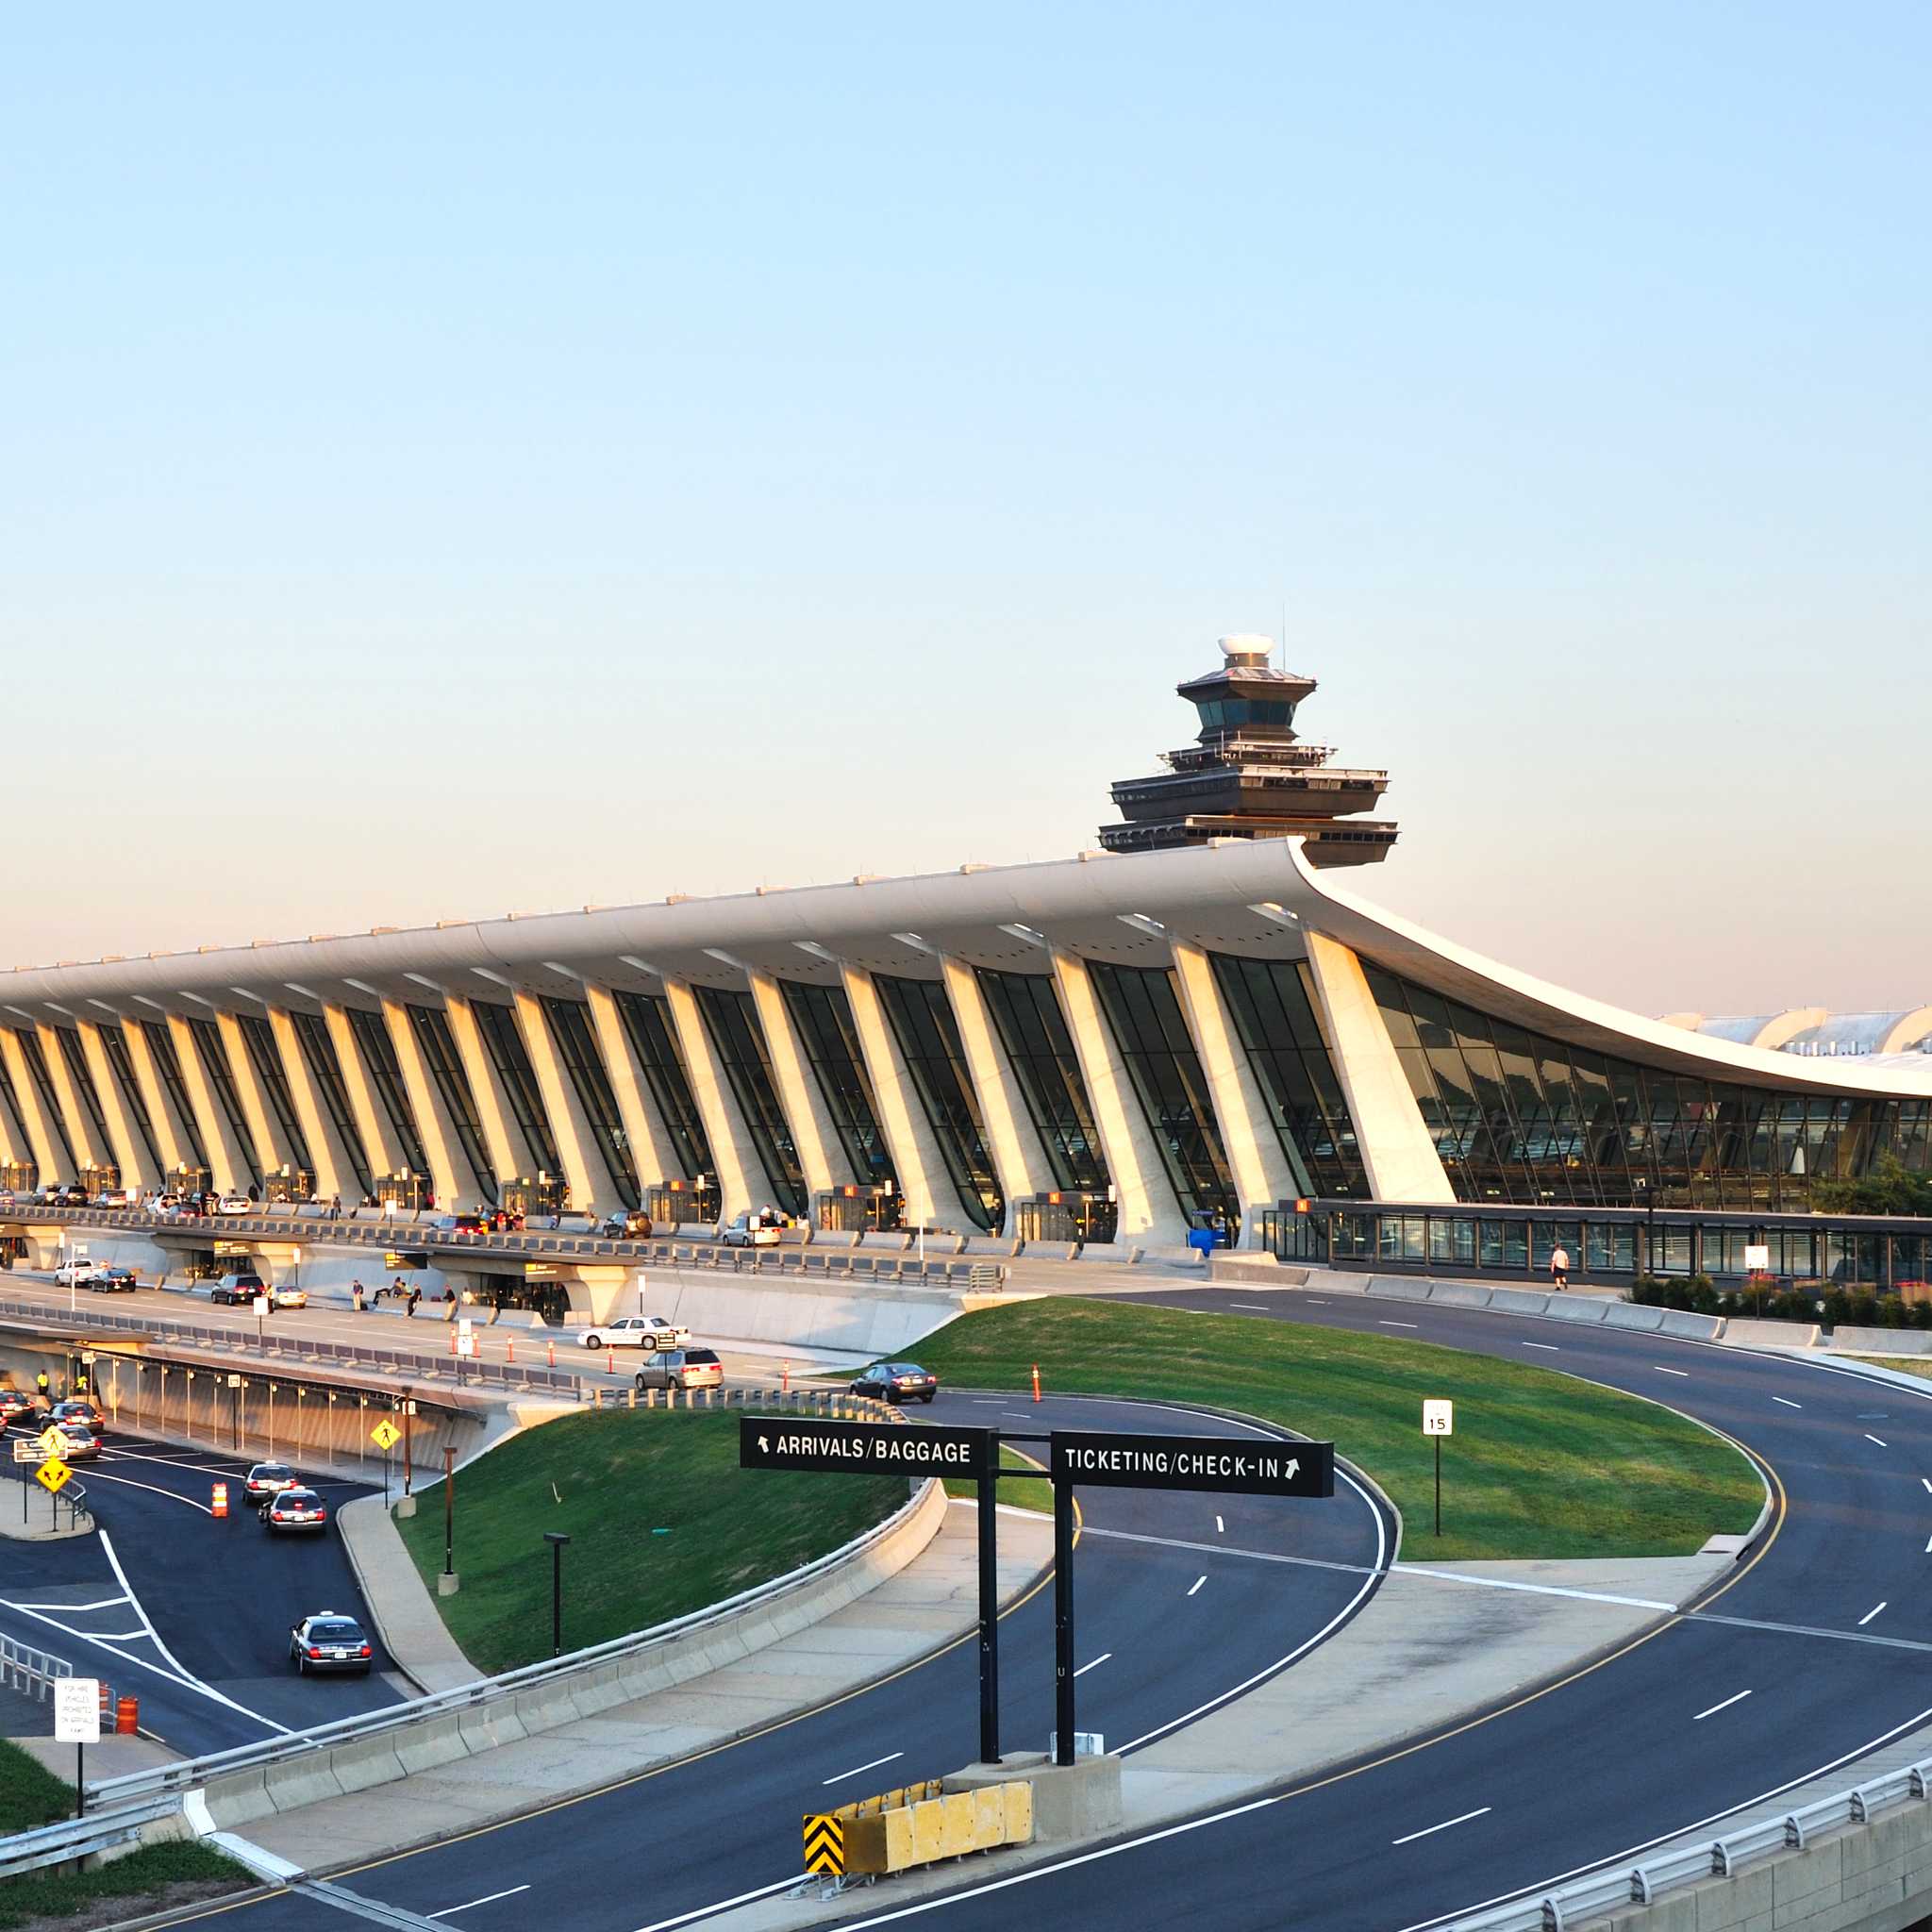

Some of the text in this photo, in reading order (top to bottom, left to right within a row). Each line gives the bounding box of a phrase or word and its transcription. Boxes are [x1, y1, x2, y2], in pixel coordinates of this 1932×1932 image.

[1430, 1418, 1445, 1430] 15
[776, 1436, 971, 1462] ARRIVALS/BAGGAGE
[1065, 1448, 1278, 1478] TICKETING/CHECK-IN
